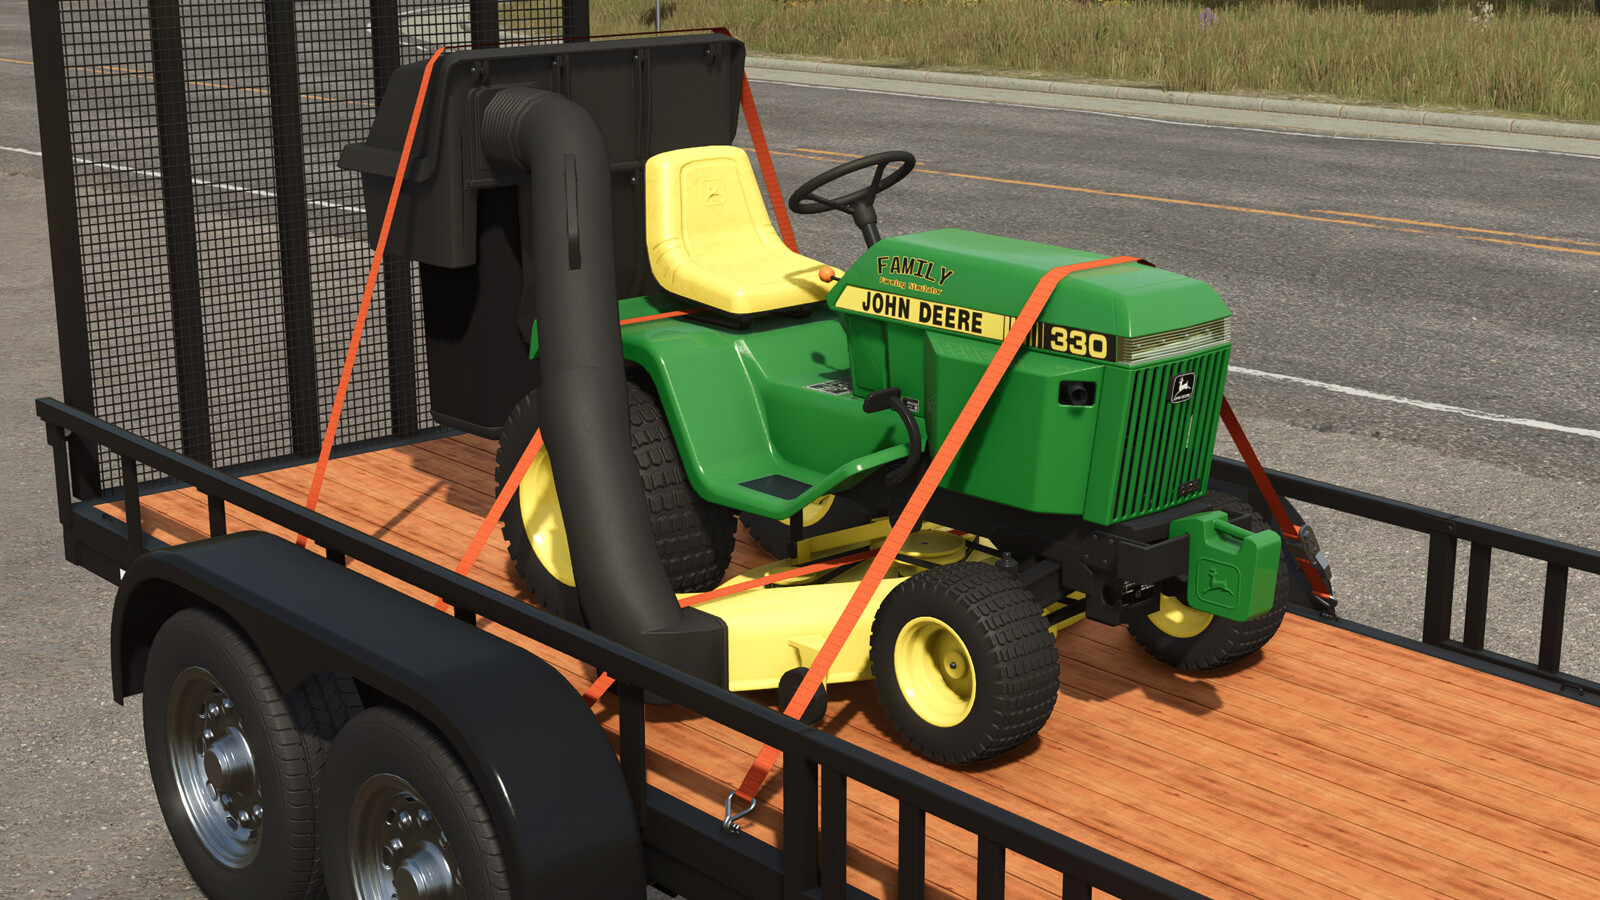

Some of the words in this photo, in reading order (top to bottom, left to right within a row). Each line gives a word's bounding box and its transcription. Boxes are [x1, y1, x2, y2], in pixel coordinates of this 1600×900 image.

[877, 256, 954, 286] FAMILY
[880, 277, 906, 289] Farming
[908, 282, 943, 295] Simulator
[862, 291, 910, 319] JOHN
[919, 301, 983, 334] DEERE
[1050, 326, 1108, 359] 330
